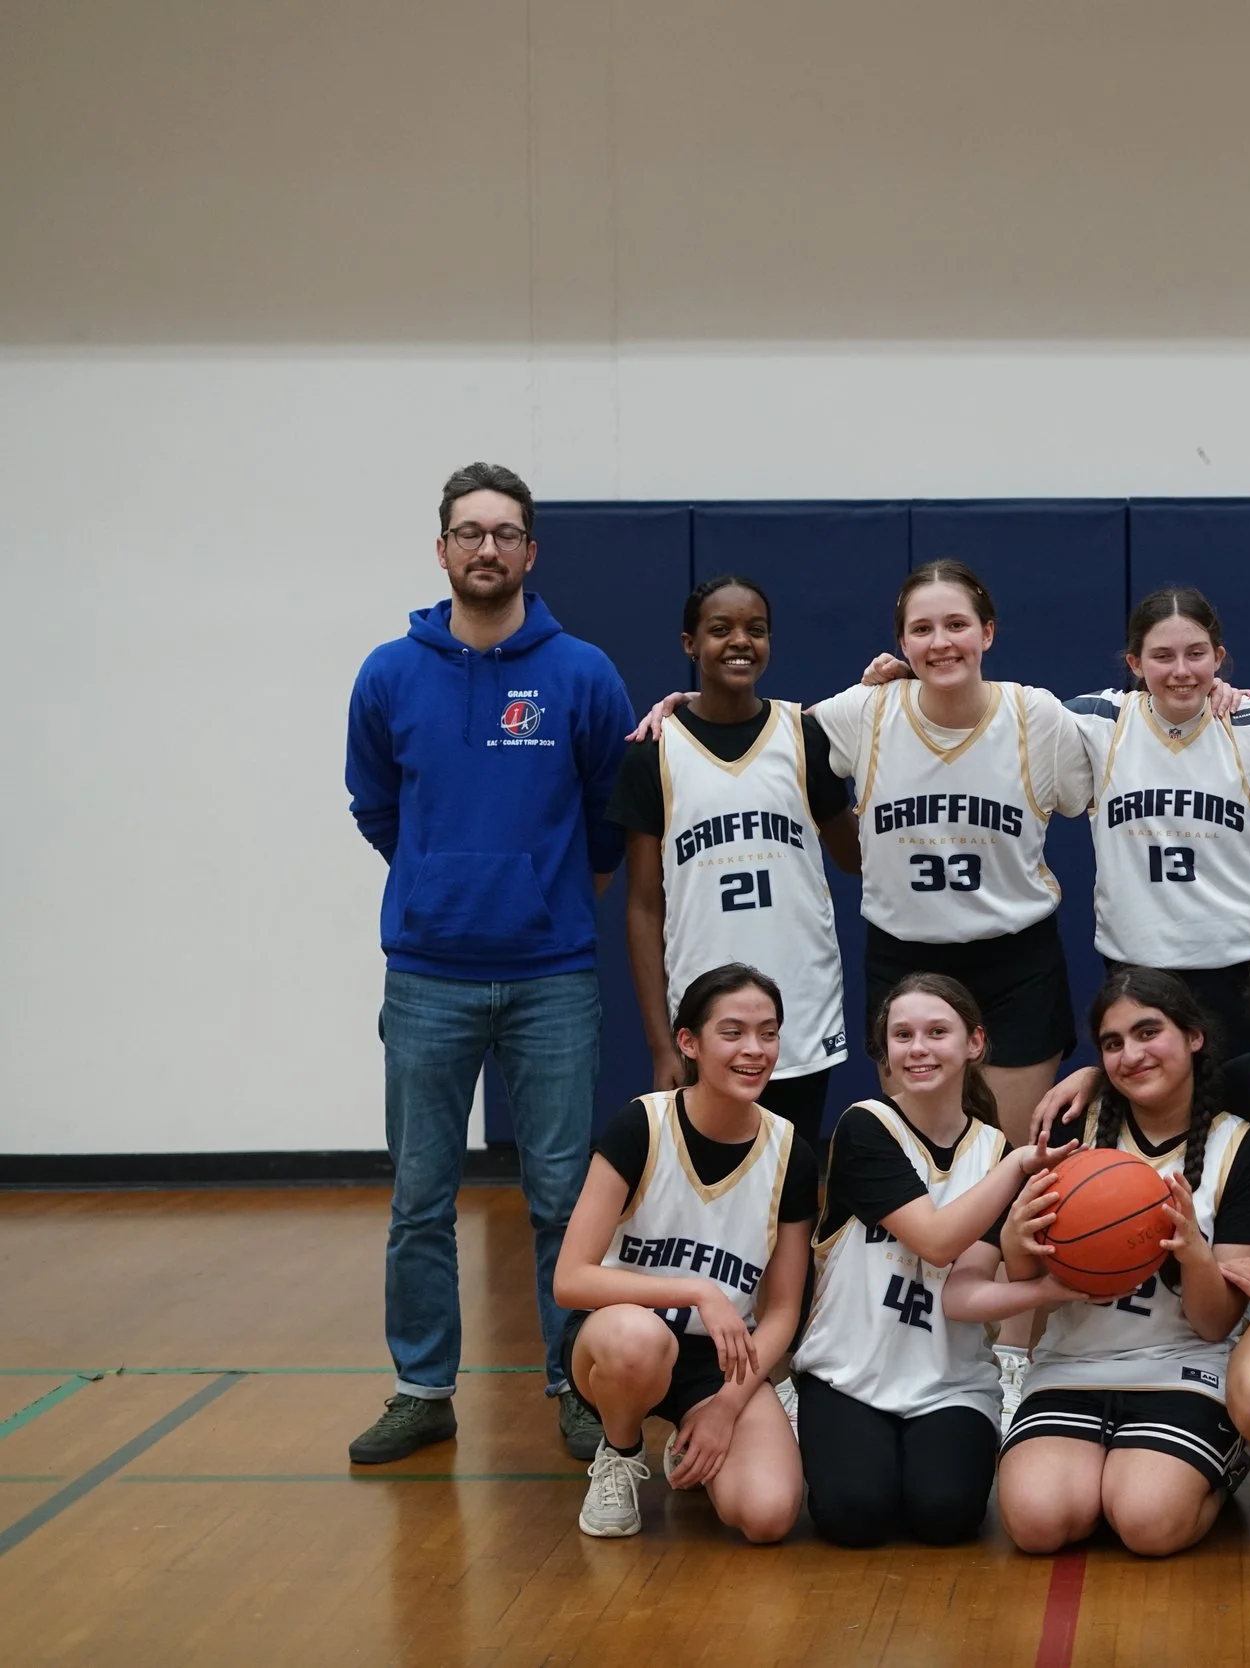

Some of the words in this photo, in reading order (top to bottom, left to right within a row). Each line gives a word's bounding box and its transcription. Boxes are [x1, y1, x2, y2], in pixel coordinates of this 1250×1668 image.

[507, 690, 531, 698] GRADE
[874, 793, 1024, 838] GRIFFINS
[1107, 788, 1245, 833] GRIFFINS
[674, 810, 805, 867] GRIFFINS
[898, 836, 998, 846] BASKETBALL
[1128, 829, 1221, 839] BASKETBALL
[909, 853, 982, 892] 33
[1148, 845, 1197, 883] 13
[719, 869, 773, 913] 21
[618, 1234, 764, 1296] GRIFFINS
[882, 1273, 934, 1334] 42
[1084, 1275, 1158, 1317] 2
